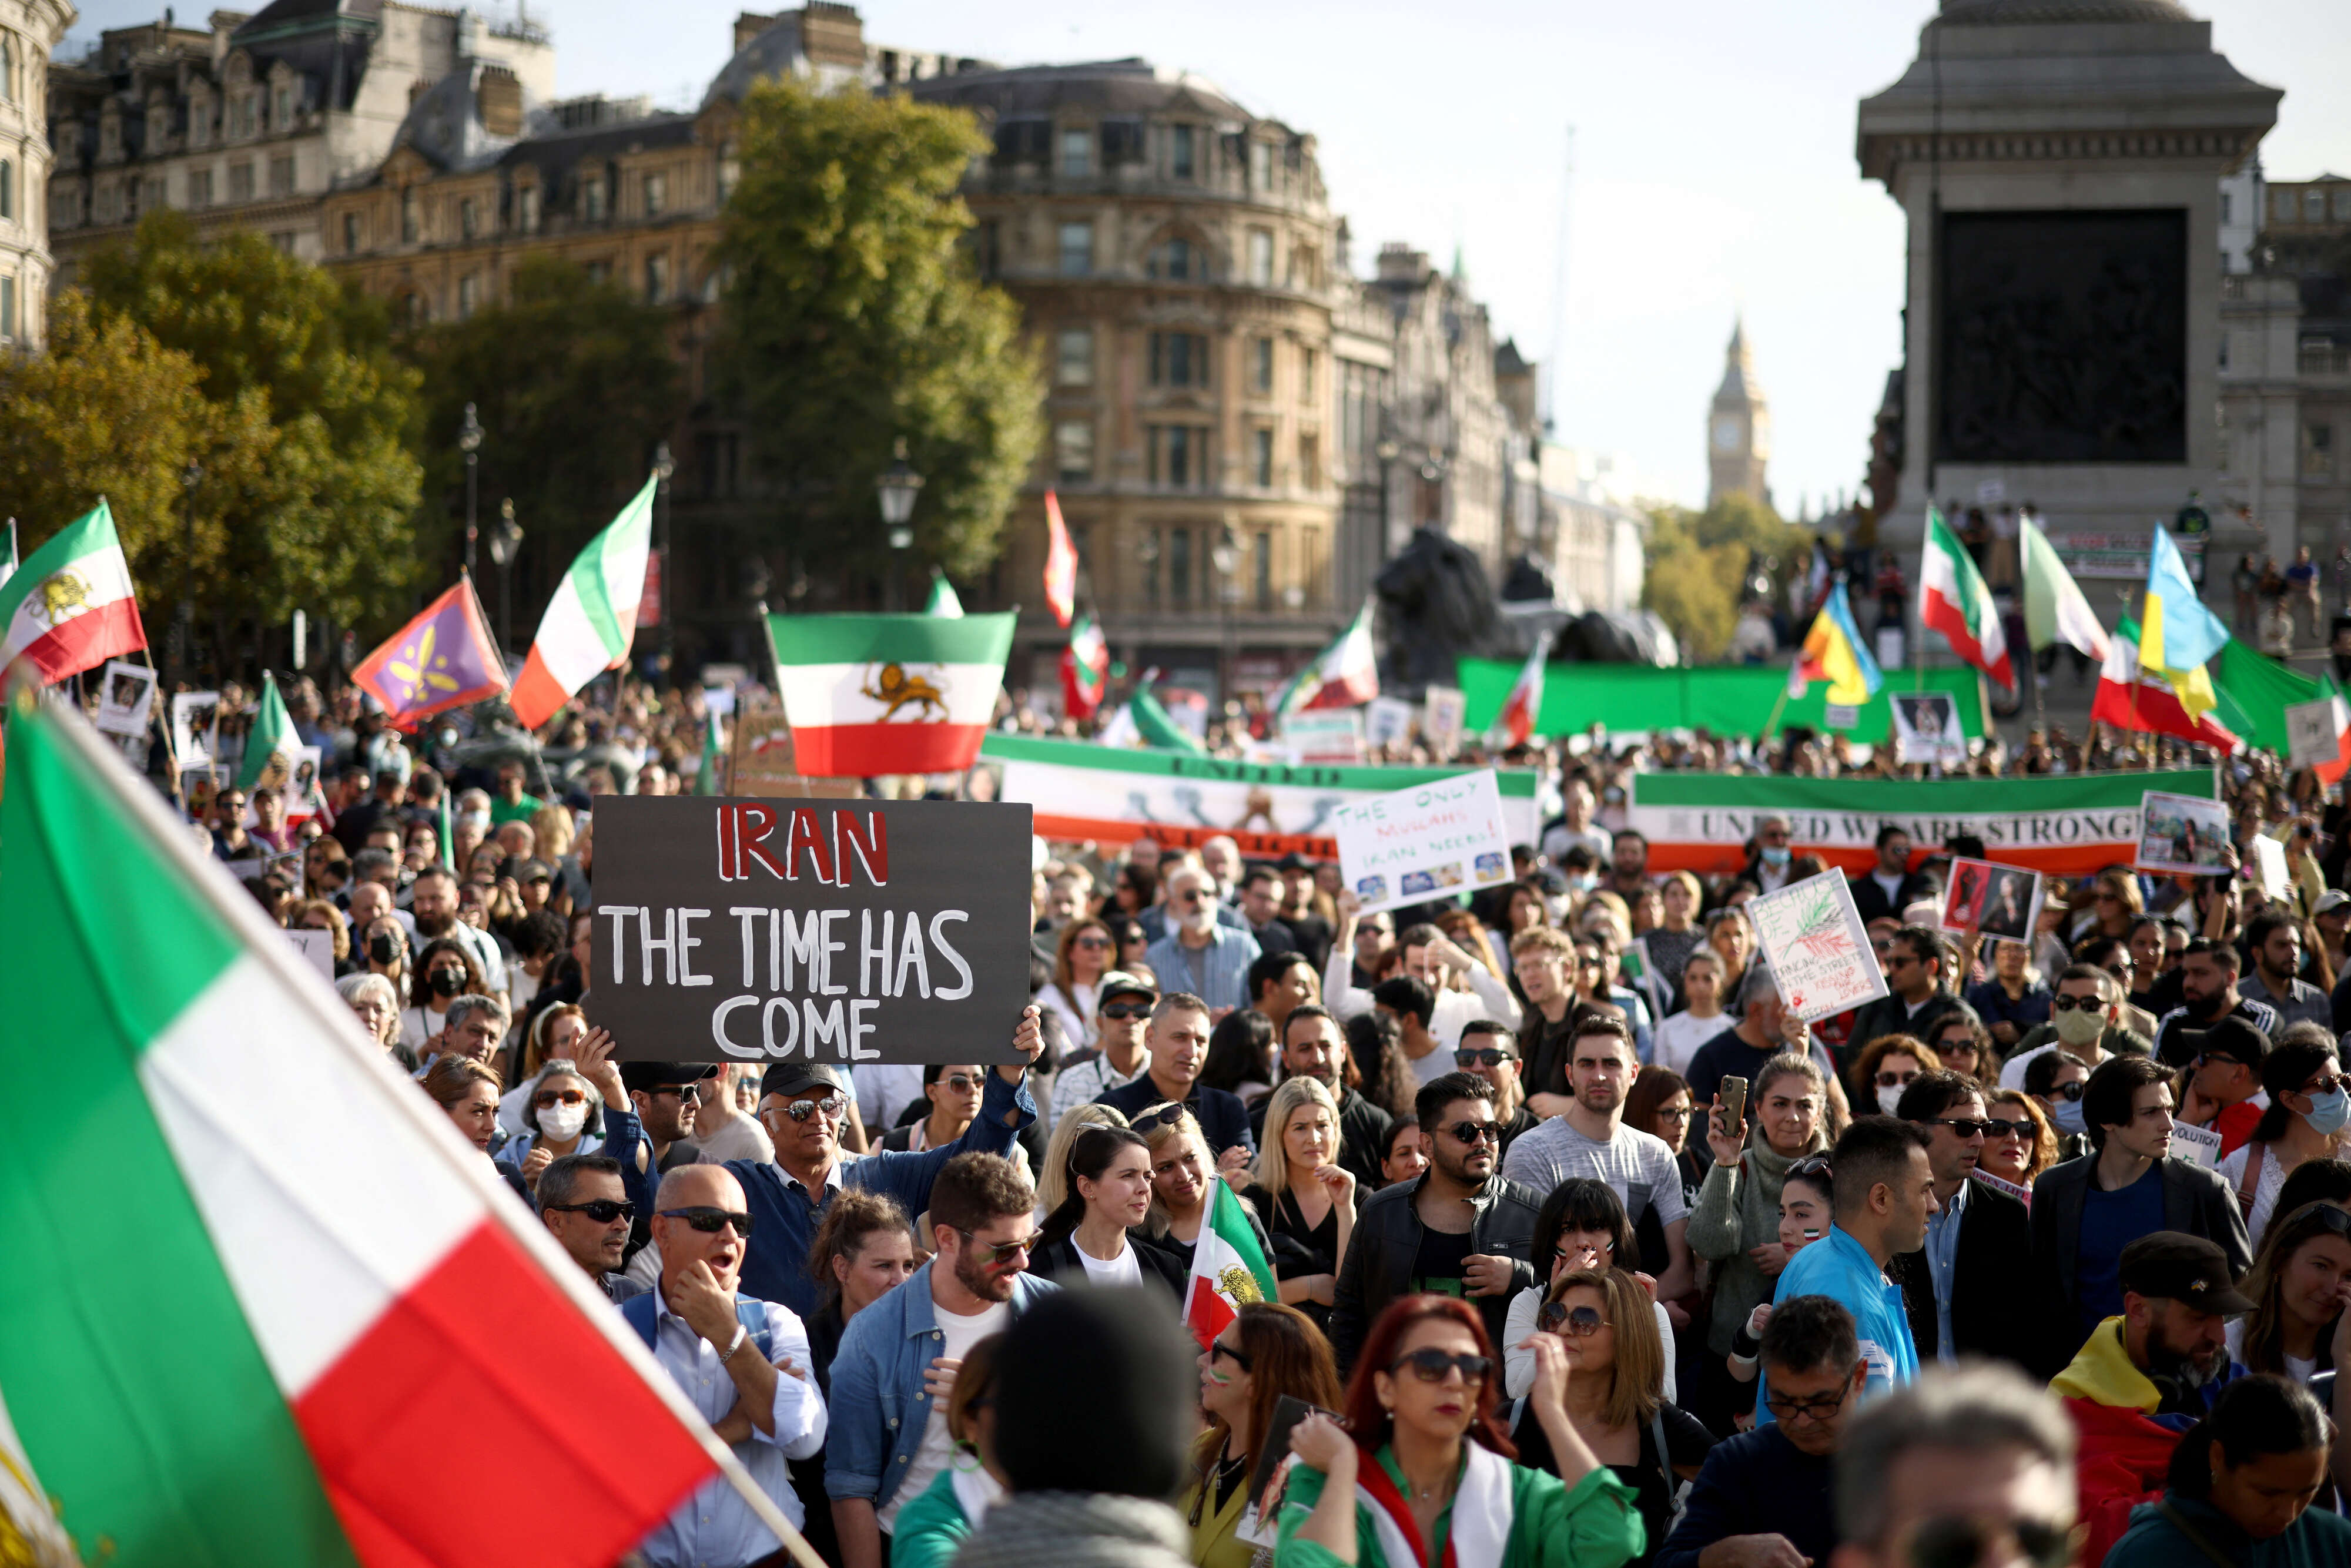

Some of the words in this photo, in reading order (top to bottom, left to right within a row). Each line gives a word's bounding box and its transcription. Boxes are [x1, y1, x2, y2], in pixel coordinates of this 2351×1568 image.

[1336, 799, 1387, 826] THE
[1415, 780, 1478, 808] ONLY
[716, 803, 889, 887] IRAN
[598, 906, 714, 987] THE
[729, 907, 850, 996] TIME
[861, 908, 973, 1001] HAS
[1820, 950, 1865, 975] STREETS
[713, 995, 880, 1060] COME
[2172, 1127, 2219, 1149] VOLUTION
[1972, 1171, 1999, 1188] OMEN
